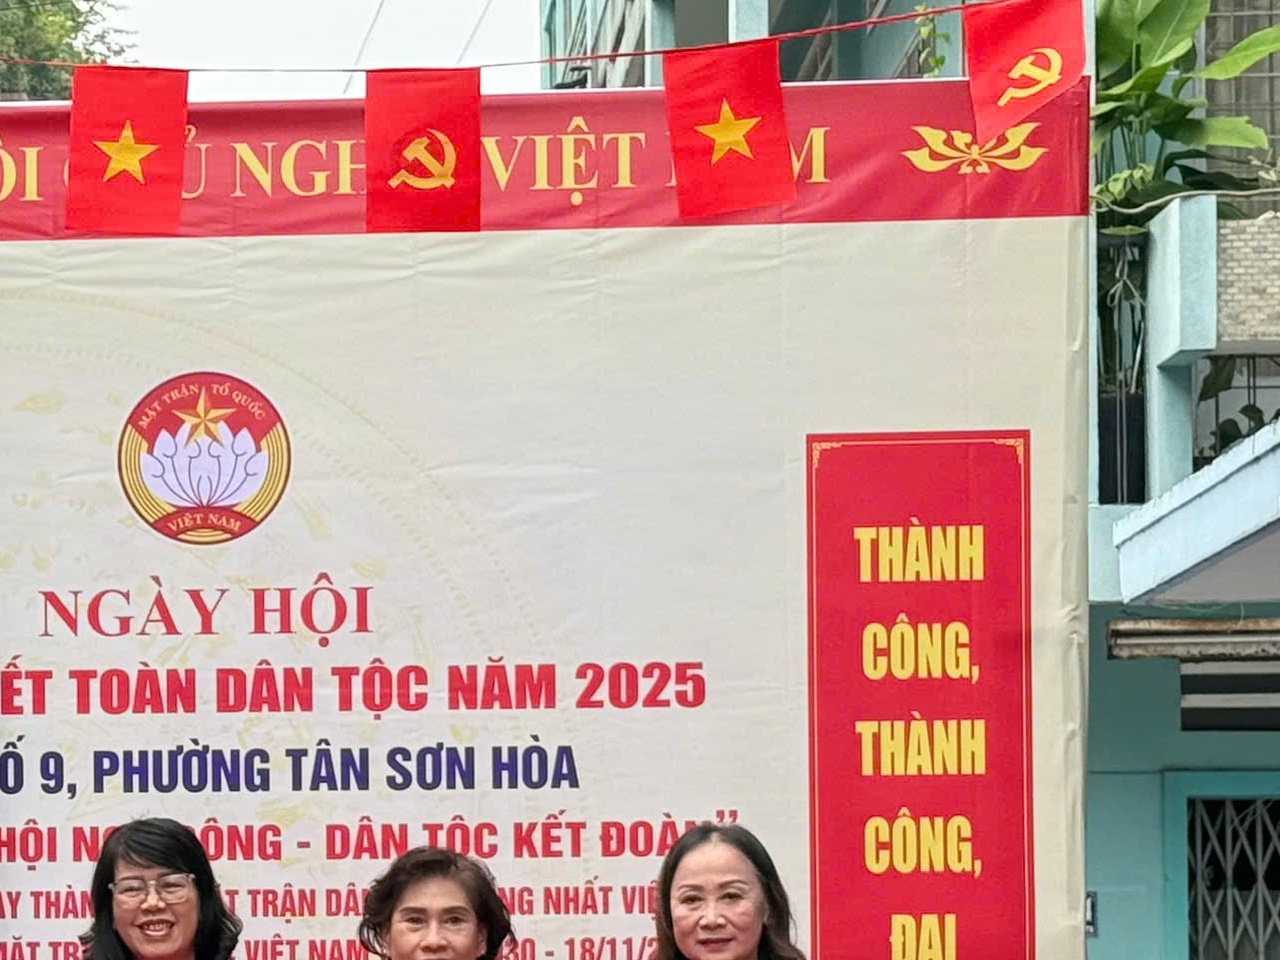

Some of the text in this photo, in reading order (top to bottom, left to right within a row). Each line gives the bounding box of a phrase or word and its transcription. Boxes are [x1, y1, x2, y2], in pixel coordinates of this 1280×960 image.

[230, 139, 367, 198] NGH
[480, 116, 645, 206] VIỆT
[207, 513, 242, 531] NAM
[853, 516, 985, 582] THÀNH
[38, 572, 374, 648] NGÀY HỘI
[862, 612, 980, 684] CÔNG,
[68, 660, 196, 714] TOÀN
[216, 659, 313, 713] DÂN
[331, 657, 429, 720] TỘC
[447, 656, 556, 710] NĂM
[575, 661, 706, 709] 2025
[40, 751, 77, 800] 9,
[93, 738, 271, 793] PHƯỜNG
[285, 738, 370, 791] TÂN
[386, 742, 475, 790] SƠN
[492, 734, 580, 789] HÒA
[855, 710, 986, 776] THÀNH
[188, 817, 282, 861] ÔNG
[326, 816, 408, 860] DÂN
[513, 809, 587, 858] KẾT
[864, 806, 982, 879] CÔNG,
[30, 884, 96, 919] THÀN
[247, 883, 316, 924] TRẬN
[543, 875, 613, 915] NHẤT
